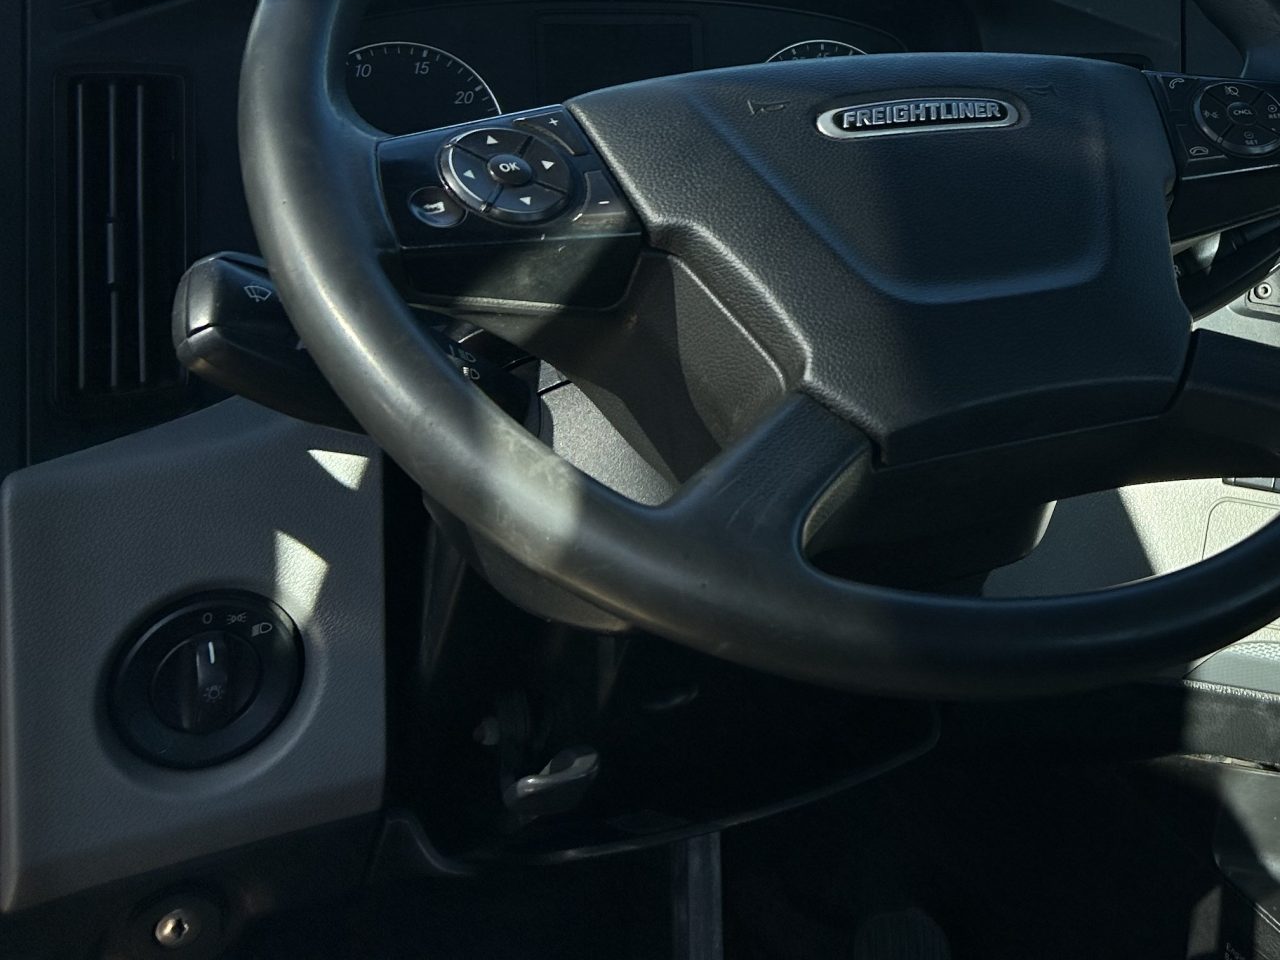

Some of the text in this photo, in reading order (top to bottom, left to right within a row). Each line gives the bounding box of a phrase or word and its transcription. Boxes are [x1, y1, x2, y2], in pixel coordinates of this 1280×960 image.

[355, 63, 372, 78] 10
[414, 61, 430, 75] 15
[454, 91, 474, 104] 20
[843, 102, 1001, 128] FREIGHTLINER
[499, 161, 520, 173] OK
